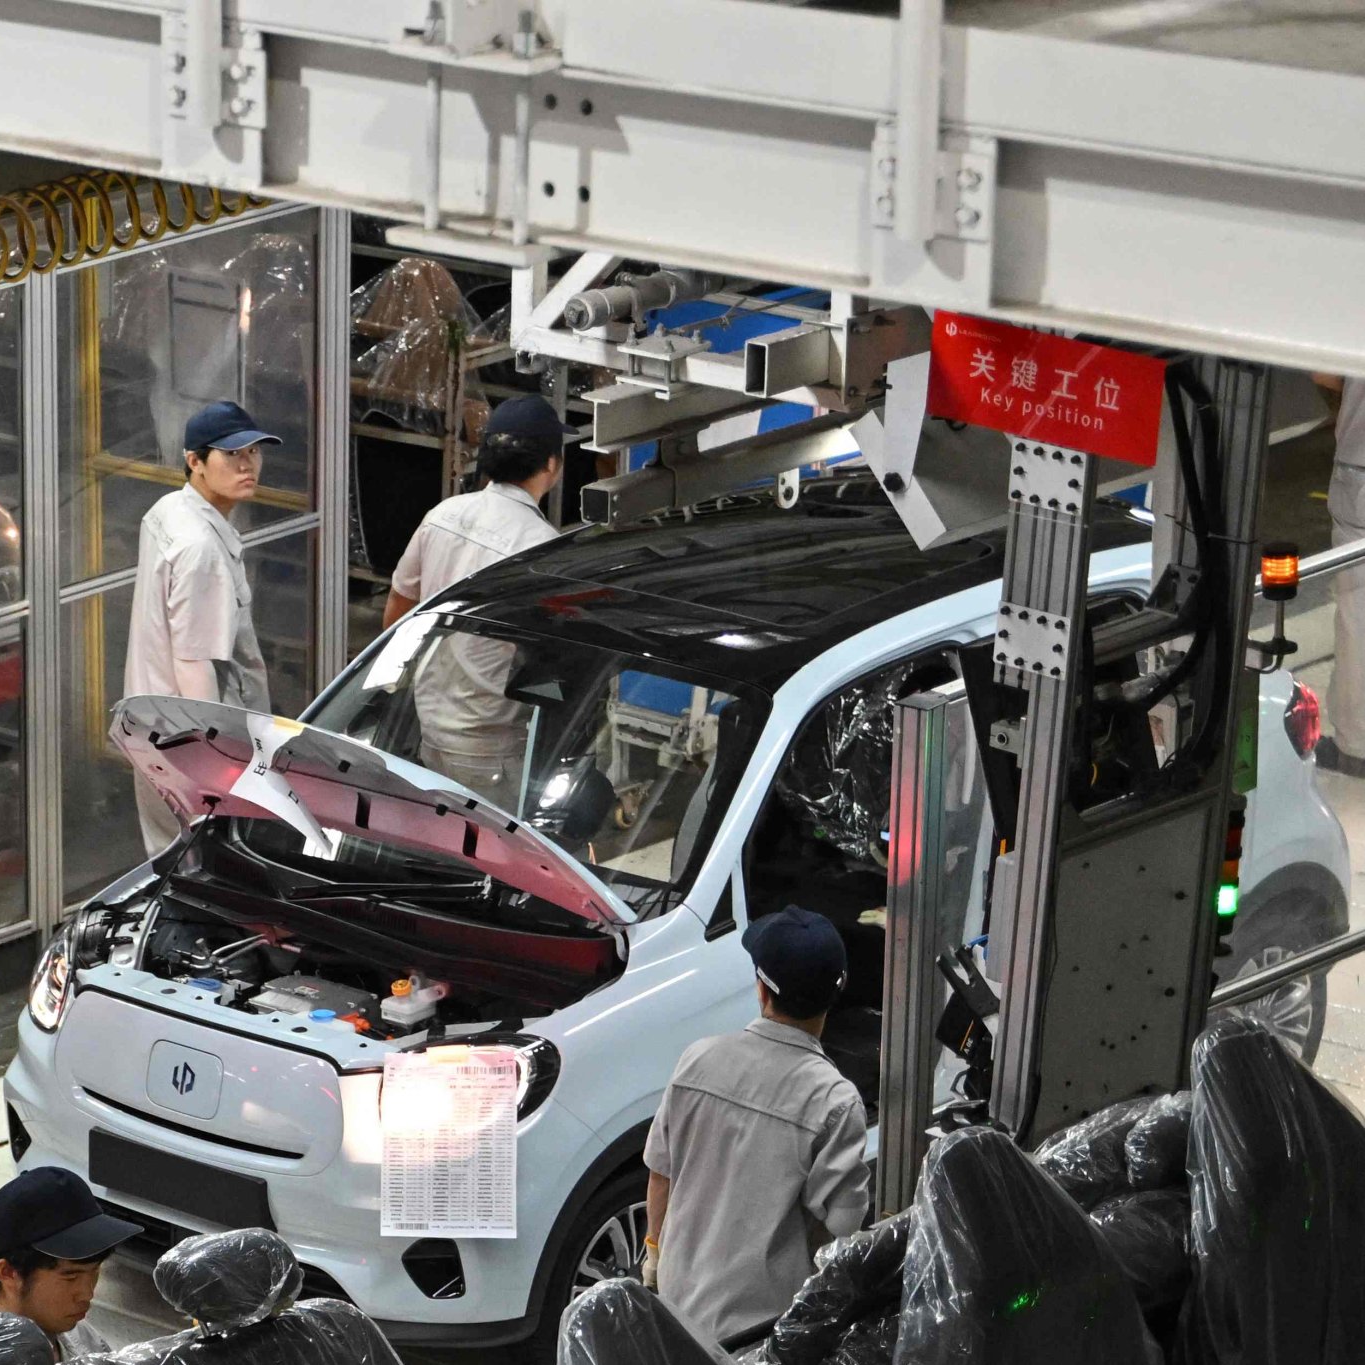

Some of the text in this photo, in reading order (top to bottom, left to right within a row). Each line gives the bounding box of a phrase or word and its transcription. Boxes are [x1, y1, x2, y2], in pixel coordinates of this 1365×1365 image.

[968, 346, 1122, 412] 关键工位
[980, 386, 1104, 431] Key position
